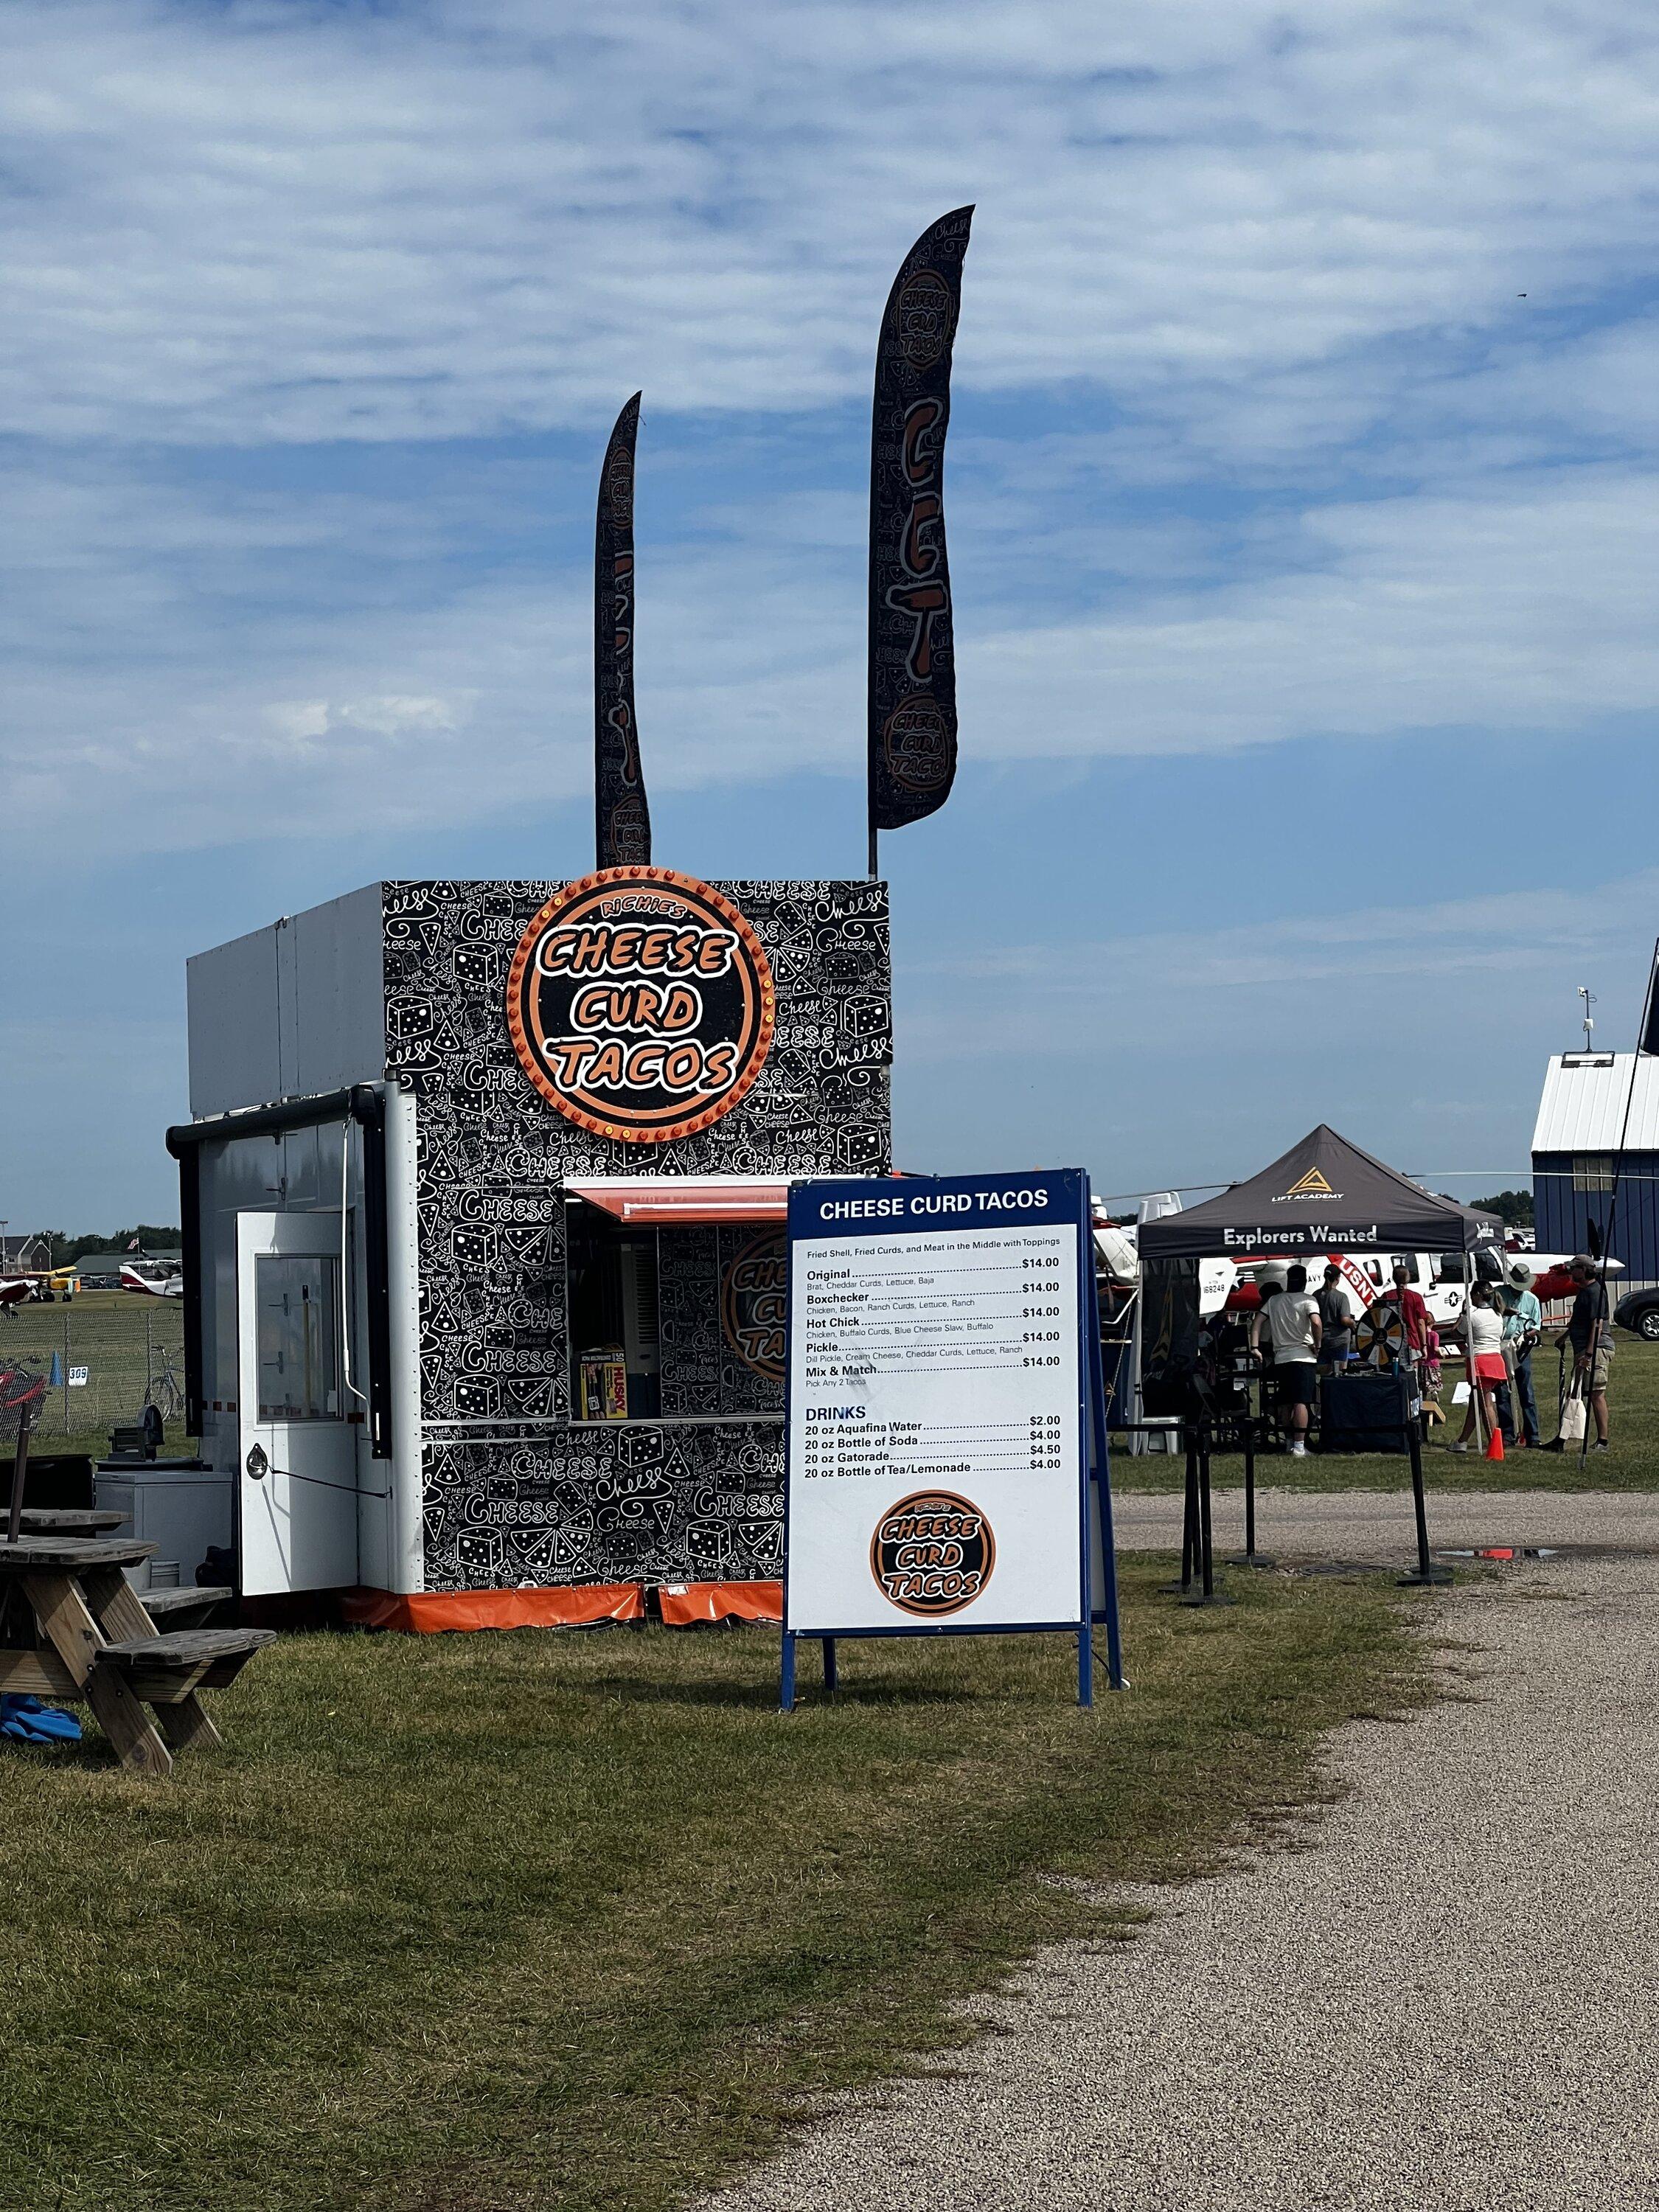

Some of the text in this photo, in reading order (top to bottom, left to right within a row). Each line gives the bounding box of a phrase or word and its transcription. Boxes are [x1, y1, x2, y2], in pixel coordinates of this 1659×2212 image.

[900, 288, 949, 310] CHEESE
[892, 711, 942, 731] CHEE
[889, 754, 945, 777] TACO
[535, 922, 739, 978] CHEESE
[569, 980, 703, 1037] CURD
[769, 1025, 835, 1048] EESE
[541, 1037, 740, 1093] TACOS
[505, 1147, 606, 1179] CHEESE
[733, 1146, 832, 1175] CHEESE
[459, 1189, 553, 1222] CHEESE
[820, 1189, 1048, 1220] CHEESE CURD TACOS
[807, 1251, 827, 1259] Fried
[924, 1244, 945, 1252] Meat
[1023, 1238, 1060, 1247] Toppings
[1224, 1225, 1377, 1251] Explorers Wanted
[807, 1258, 1059, 1281] Original $14.00
[1307, 1274, 1321, 1282] AVY
[807, 1282, 1060, 1304] Boxchecker $14.00
[919, 1300, 948, 1308] Lettuce,
[807, 1307, 1060, 1328] Hot Chick $14.00
[807, 1332, 1060, 1352] Pickle $14.00
[462, 1340, 556, 1373] CHEESE
[807, 1357, 1060, 1377] Mix & Match $14.00
[820, 1354, 843, 1363] Pickle,
[873, 1352, 903, 1360] Cheese,
[69, 1368, 86, 1379] 309
[613, 1367, 625, 1411] HUSKY
[807, 1406, 866, 1421] DRINKS
[805, 1426, 818, 1435] 20
[837, 1423, 886, 1435] Aquafina
[888, 1422, 922, 1432] Water
[1030, 1416, 1060, 1426] $2.00
[805, 1440, 818, 1450] 20
[838, 1438, 871, 1447] Bottle
[875, 1437, 886, 1446] of
[889, 1436, 918, 1446] Soda
[1030, 1430, 1060, 1440] $4.00
[511, 1450, 612, 1480] CHEESE
[805, 1455, 818, 1464] 20
[838, 1452, 889, 1462] Gatorade
[1031, 1444, 1060, 1455] $4.50
[805, 1459, 1060, 1478] 20 oz Bottle of Tea/Lemonade $4.00
[465, 1492, 559, 1525] CHEESE
[879, 1513, 981, 1543] CHEESE
[896, 1542, 963, 1570] CURD
[883, 1571, 981, 1600] TACOS
